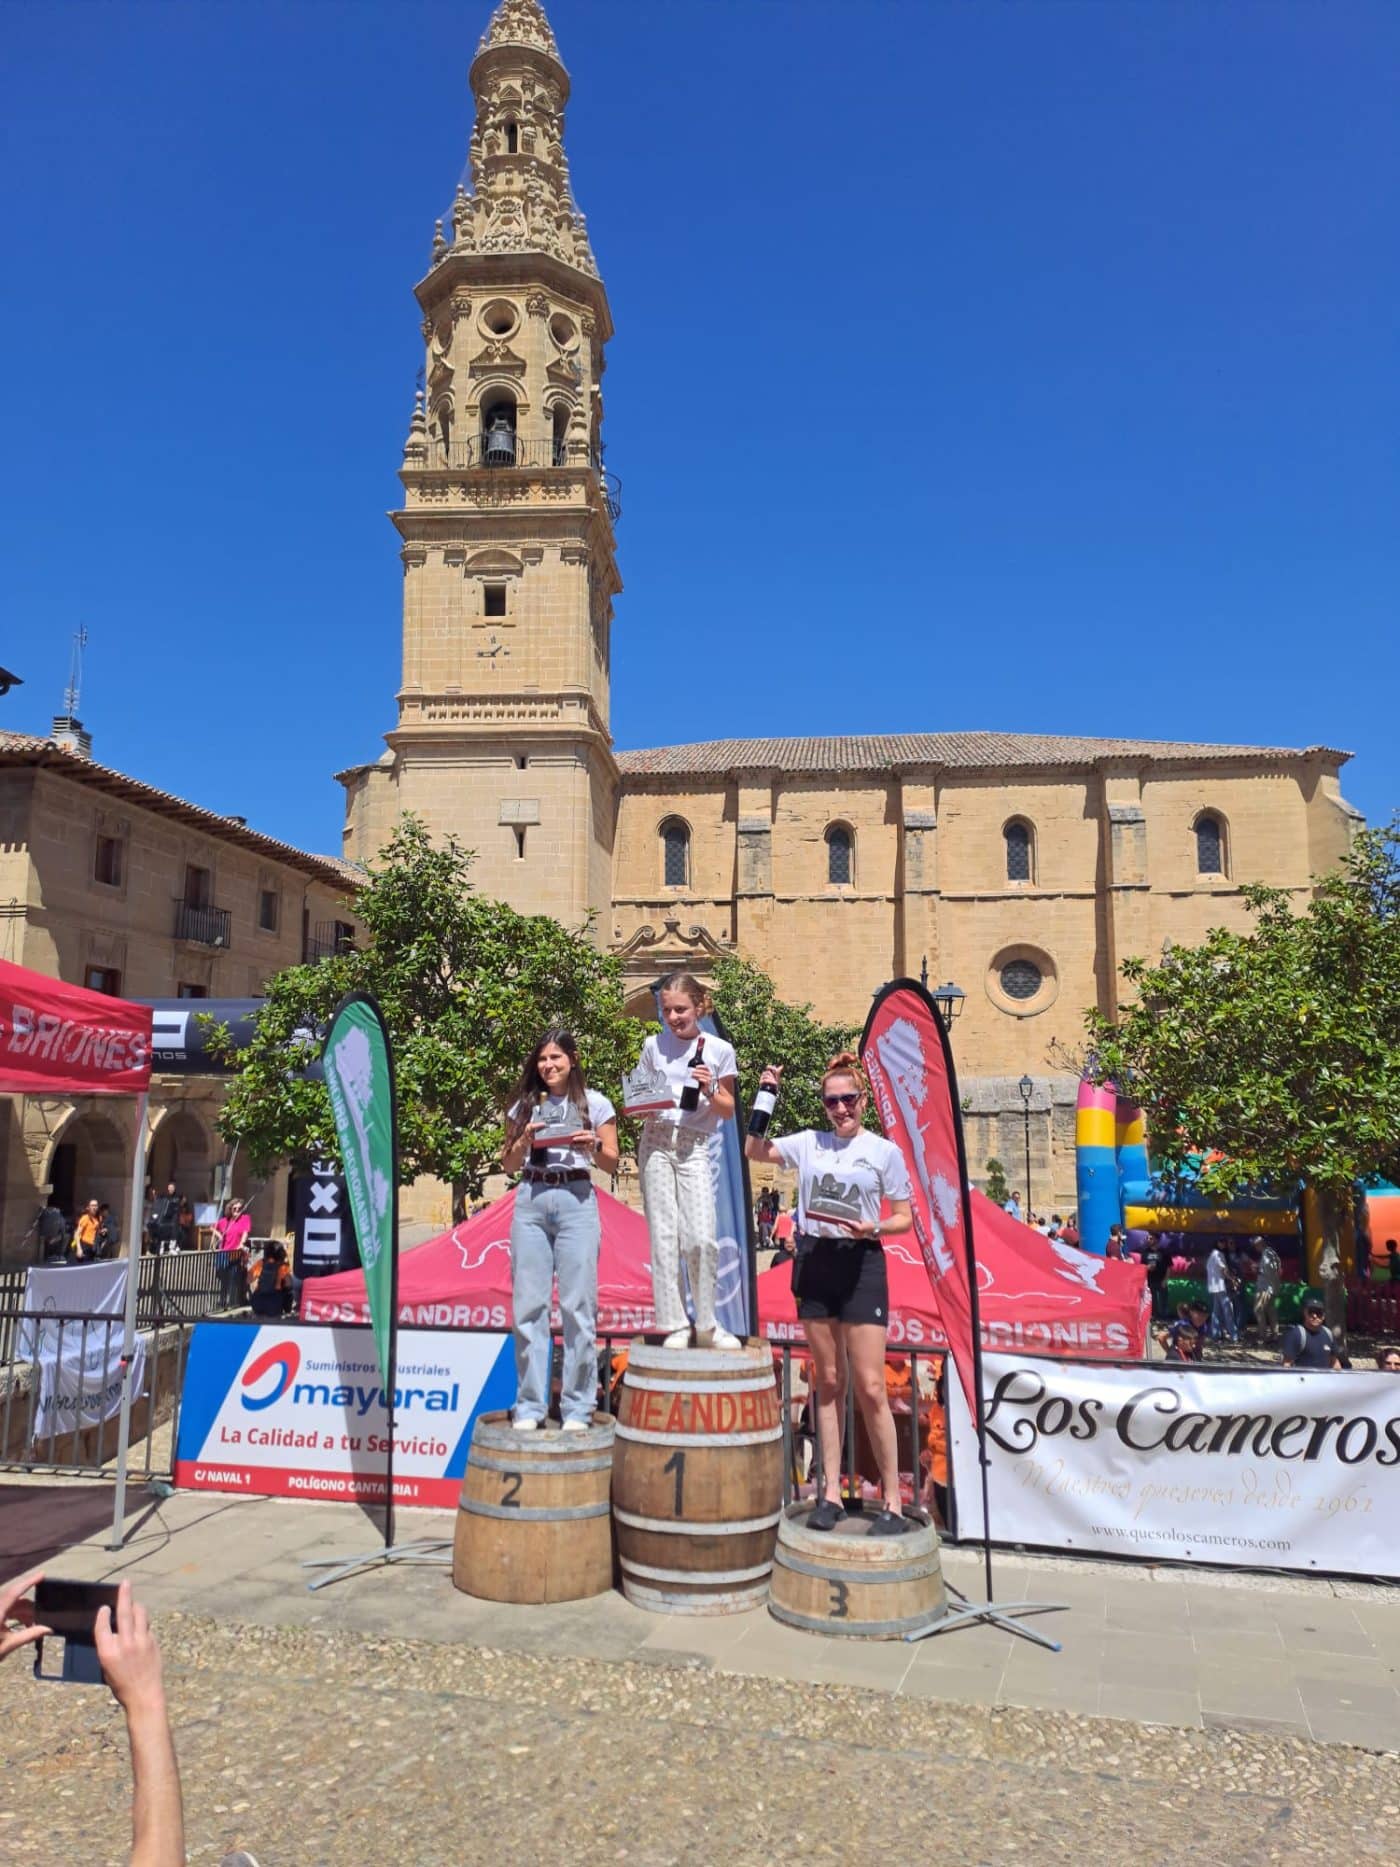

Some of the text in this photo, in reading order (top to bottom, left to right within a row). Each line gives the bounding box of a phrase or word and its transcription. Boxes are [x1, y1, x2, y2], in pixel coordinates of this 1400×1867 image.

[8, 1004, 149, 1071] BRIONES
[305, 1301, 356, 1322] LOS
[362, 1303, 507, 1328] ANDROS
[306, 1359, 451, 1377] Suministros ustriales
[293, 1382, 460, 1416] mayoral
[984, 1369, 1400, 1466] Los Cameros
[220, 1426, 447, 1456] La Calidad a tu Servicio
[194, 1470, 251, 1485] C/ NAVAL 1
[288, 1475, 345, 1492] POLÍGONO
[347, 1480, 411, 1497] CANTARIA
[501, 1472, 522, 1507] 2
[664, 1451, 685, 1516] 1
[1091, 1524, 1292, 1551] www.quesoloscameros.com
[829, 1579, 849, 1616] 3
